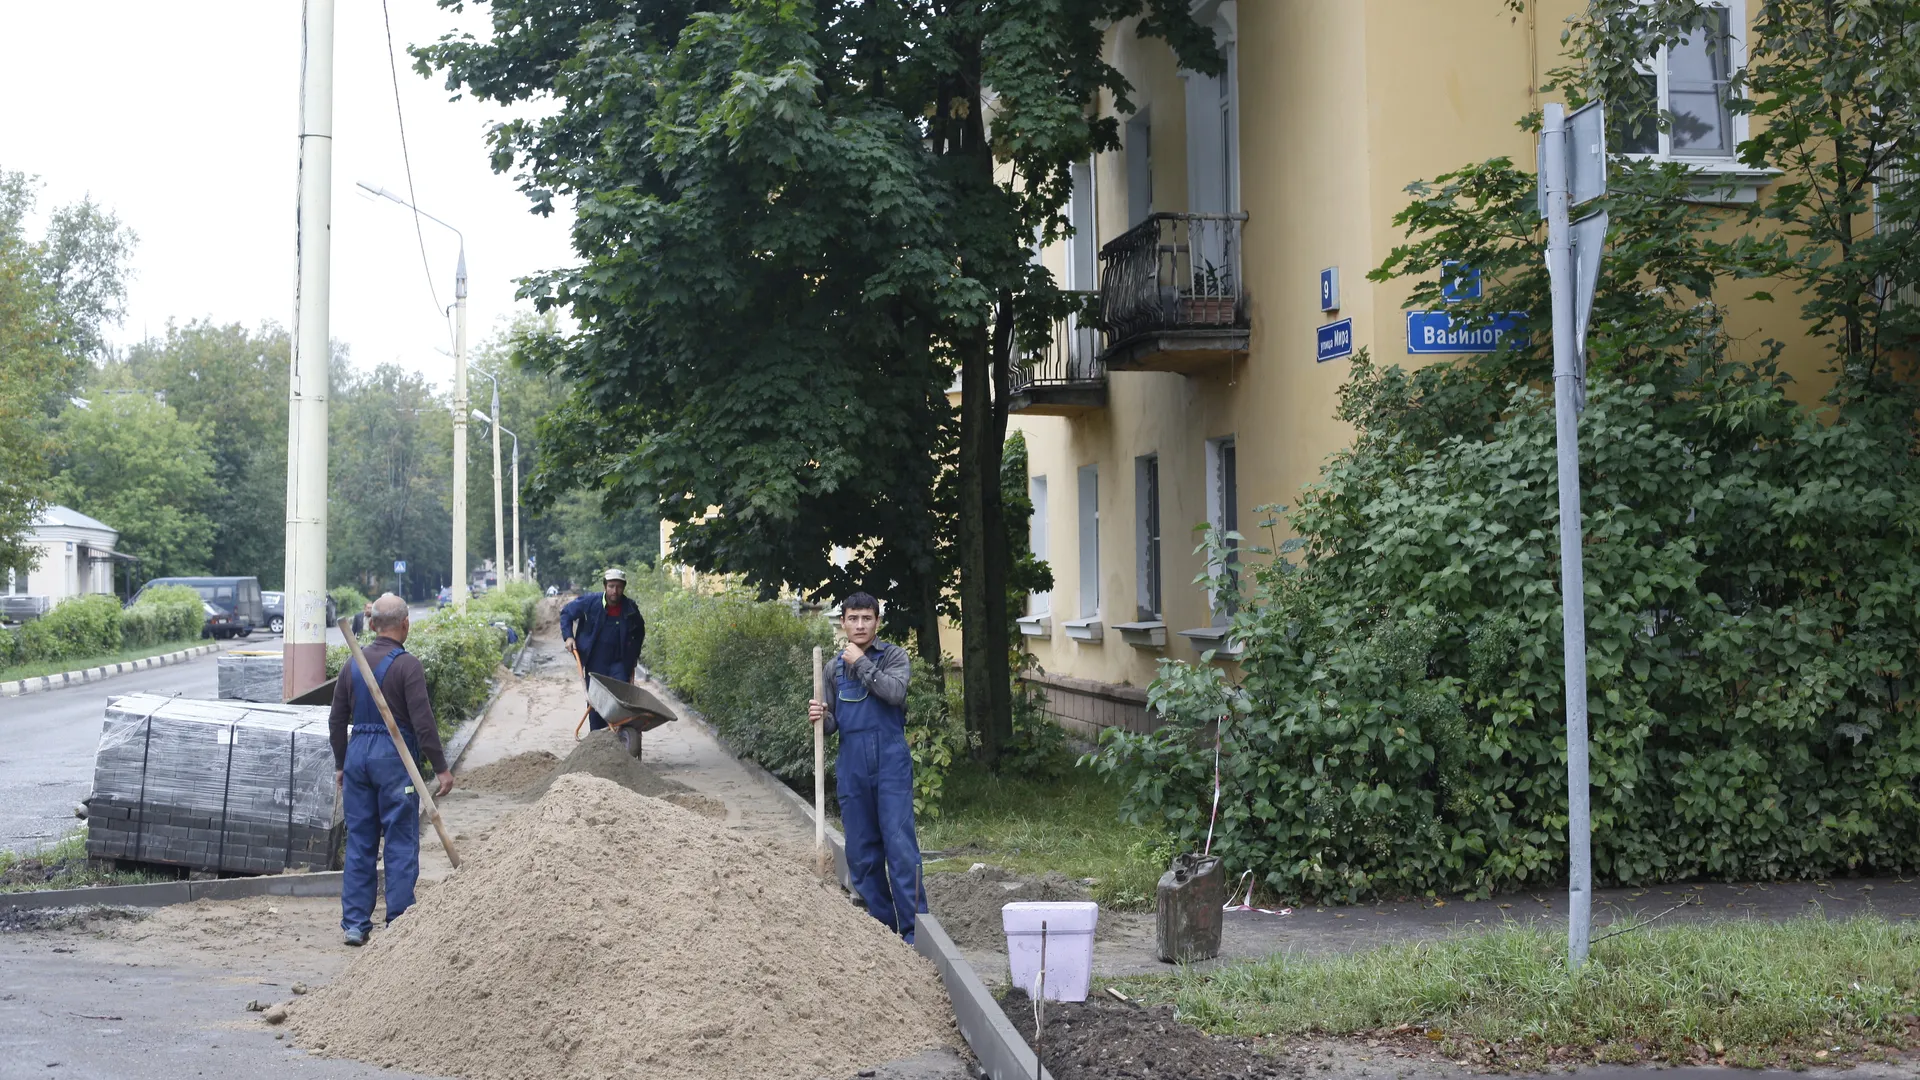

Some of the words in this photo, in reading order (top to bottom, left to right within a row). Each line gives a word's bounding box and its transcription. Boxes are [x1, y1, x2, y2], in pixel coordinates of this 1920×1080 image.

[1323, 280, 1329, 299] 9
[1320, 341, 1333, 353] улица
[1334, 329, 1349, 348] Мира
[1423, 326, 1516, 345] Вавилов
